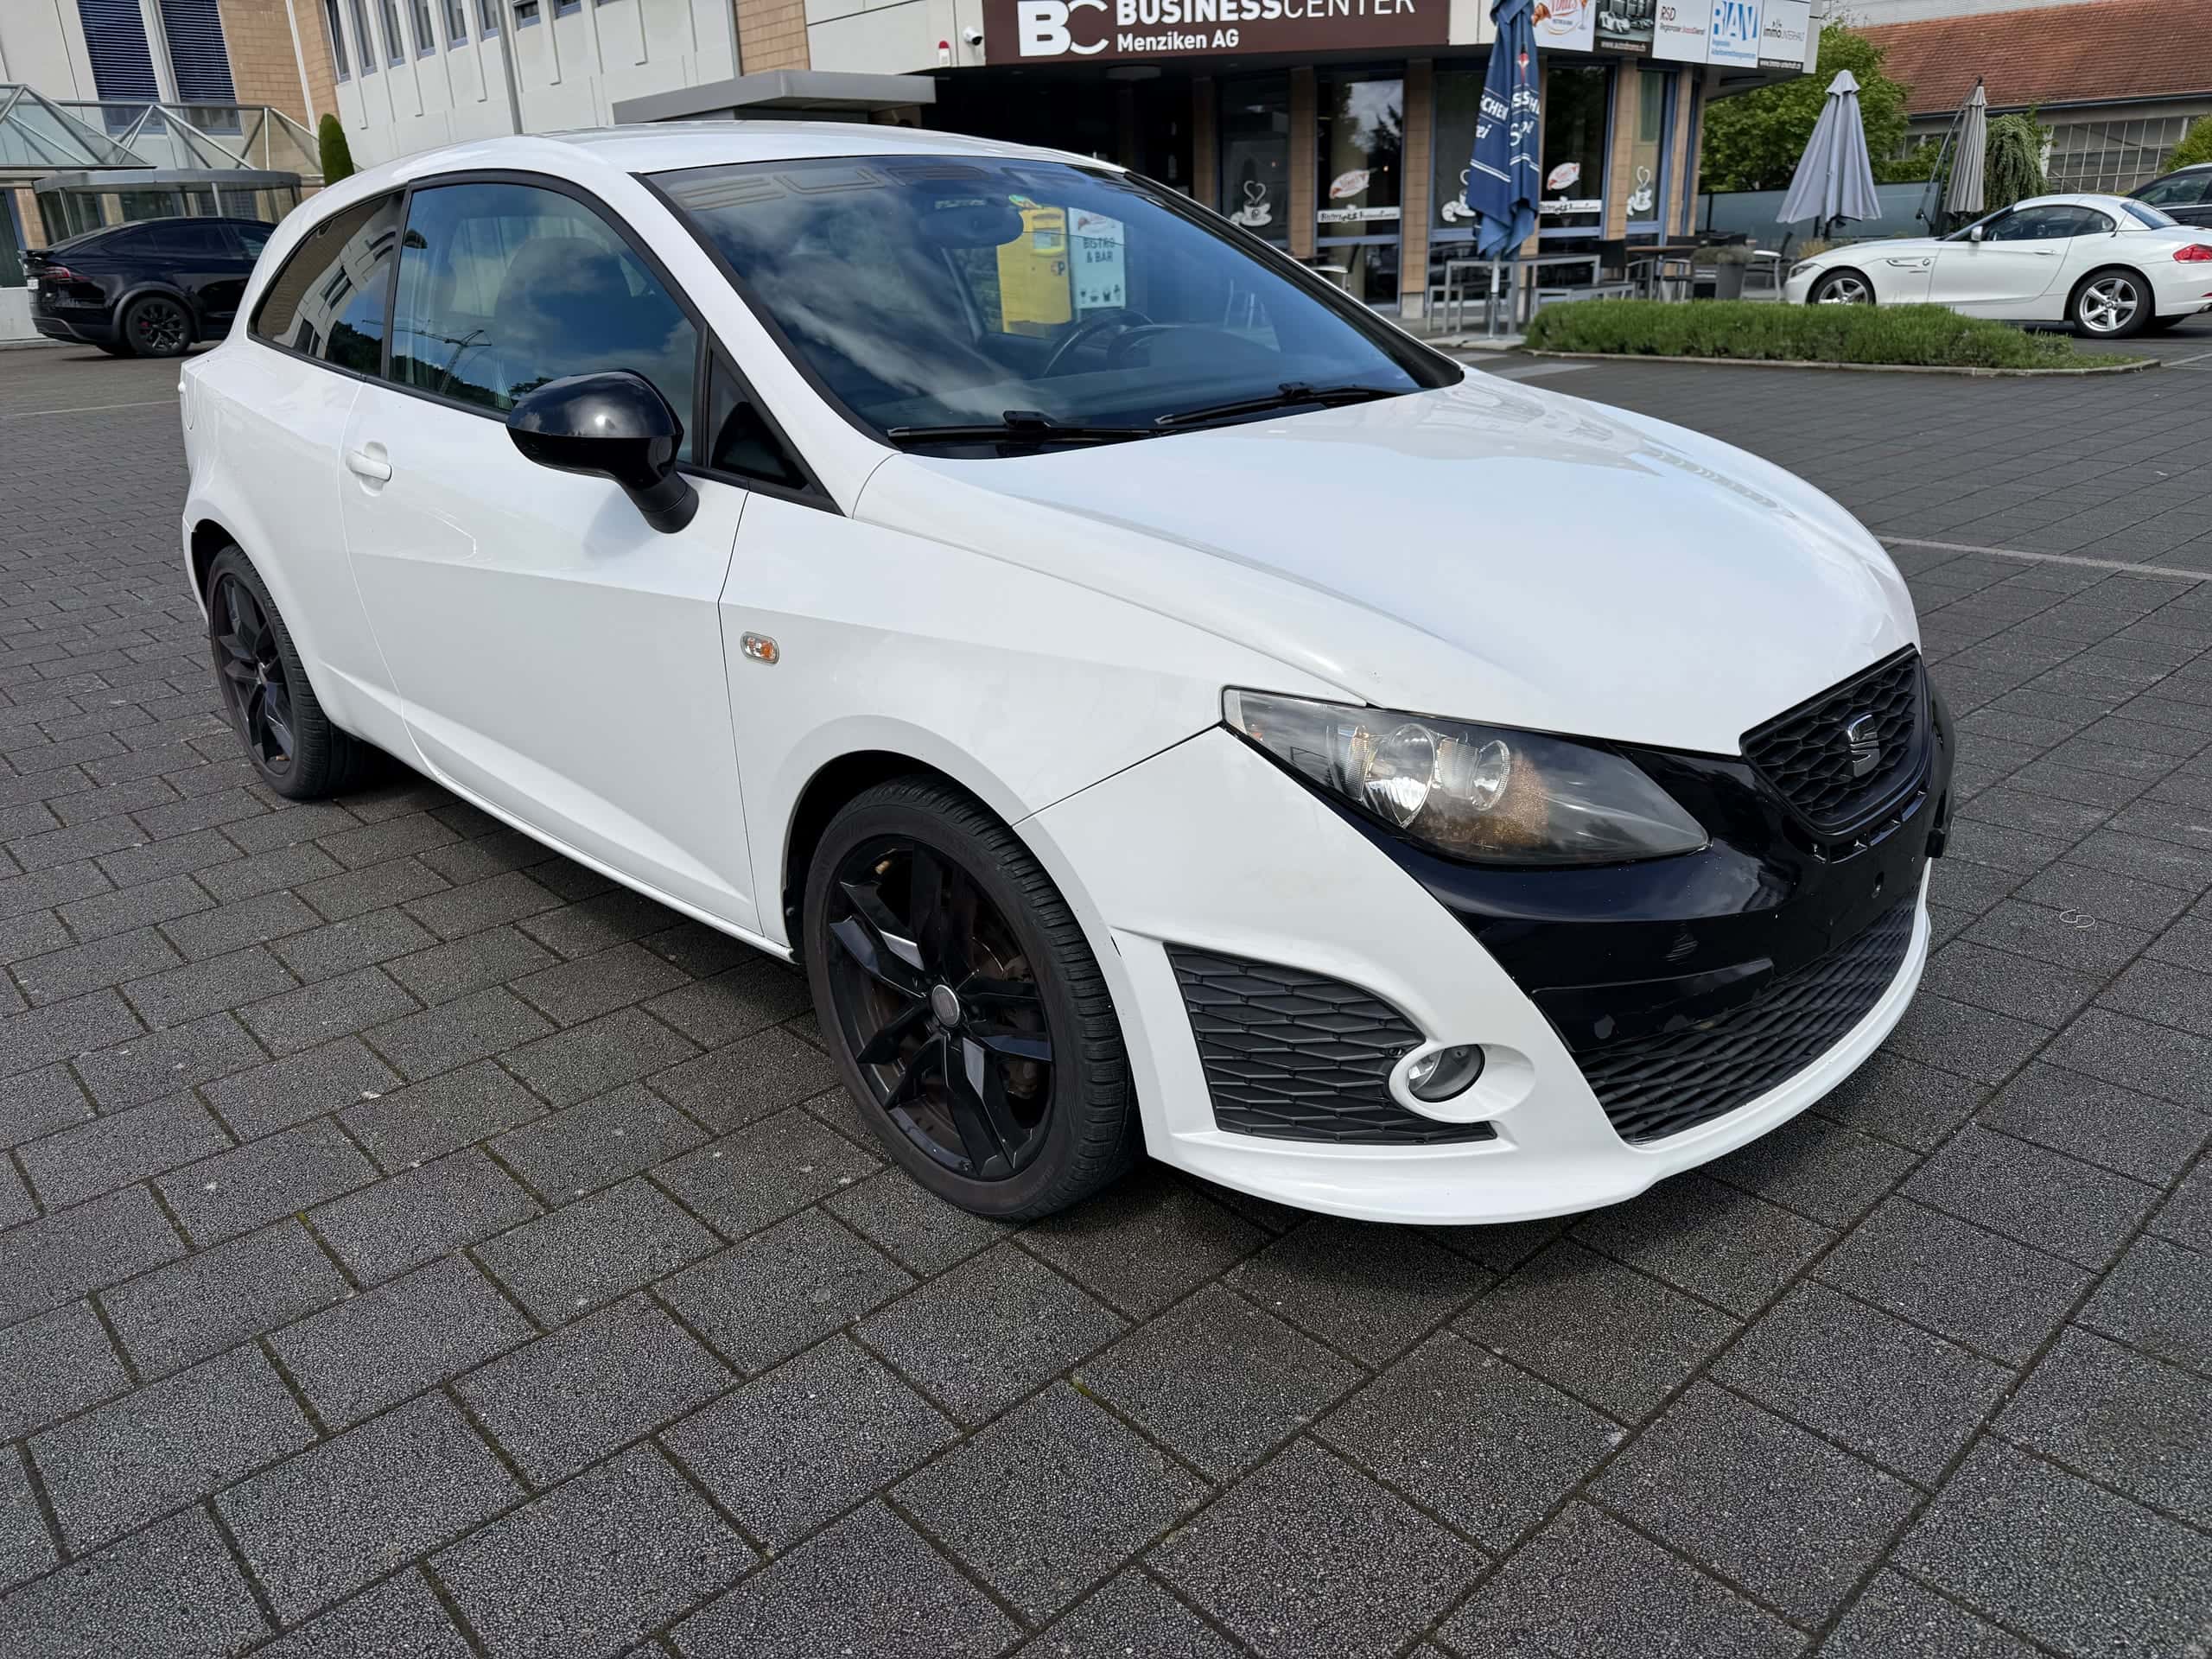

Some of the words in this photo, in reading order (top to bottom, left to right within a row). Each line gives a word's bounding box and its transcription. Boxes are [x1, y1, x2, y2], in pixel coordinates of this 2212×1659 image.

[1017, 0, 1109, 56] BC
[1117, 33, 1207, 52] Menziken
[1211, 29, 1239, 48] AG
[1095, 251, 1114, 263] BAR
